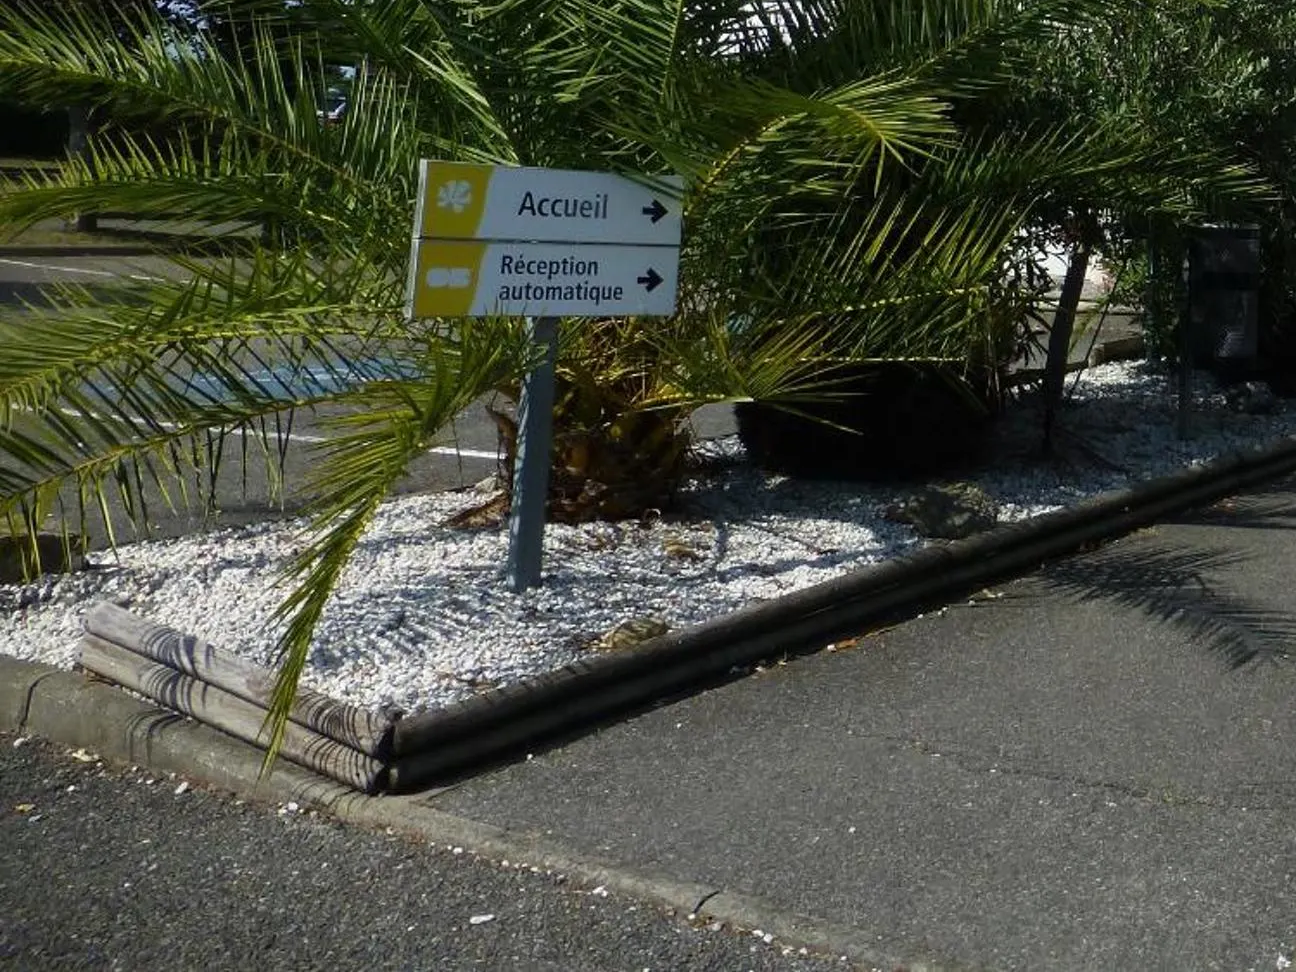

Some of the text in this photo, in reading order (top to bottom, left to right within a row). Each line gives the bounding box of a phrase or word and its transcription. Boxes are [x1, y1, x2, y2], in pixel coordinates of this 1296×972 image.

[517, 191, 609, 219] Accueil
[500, 254, 599, 279] Réception
[499, 281, 624, 305] automatique
